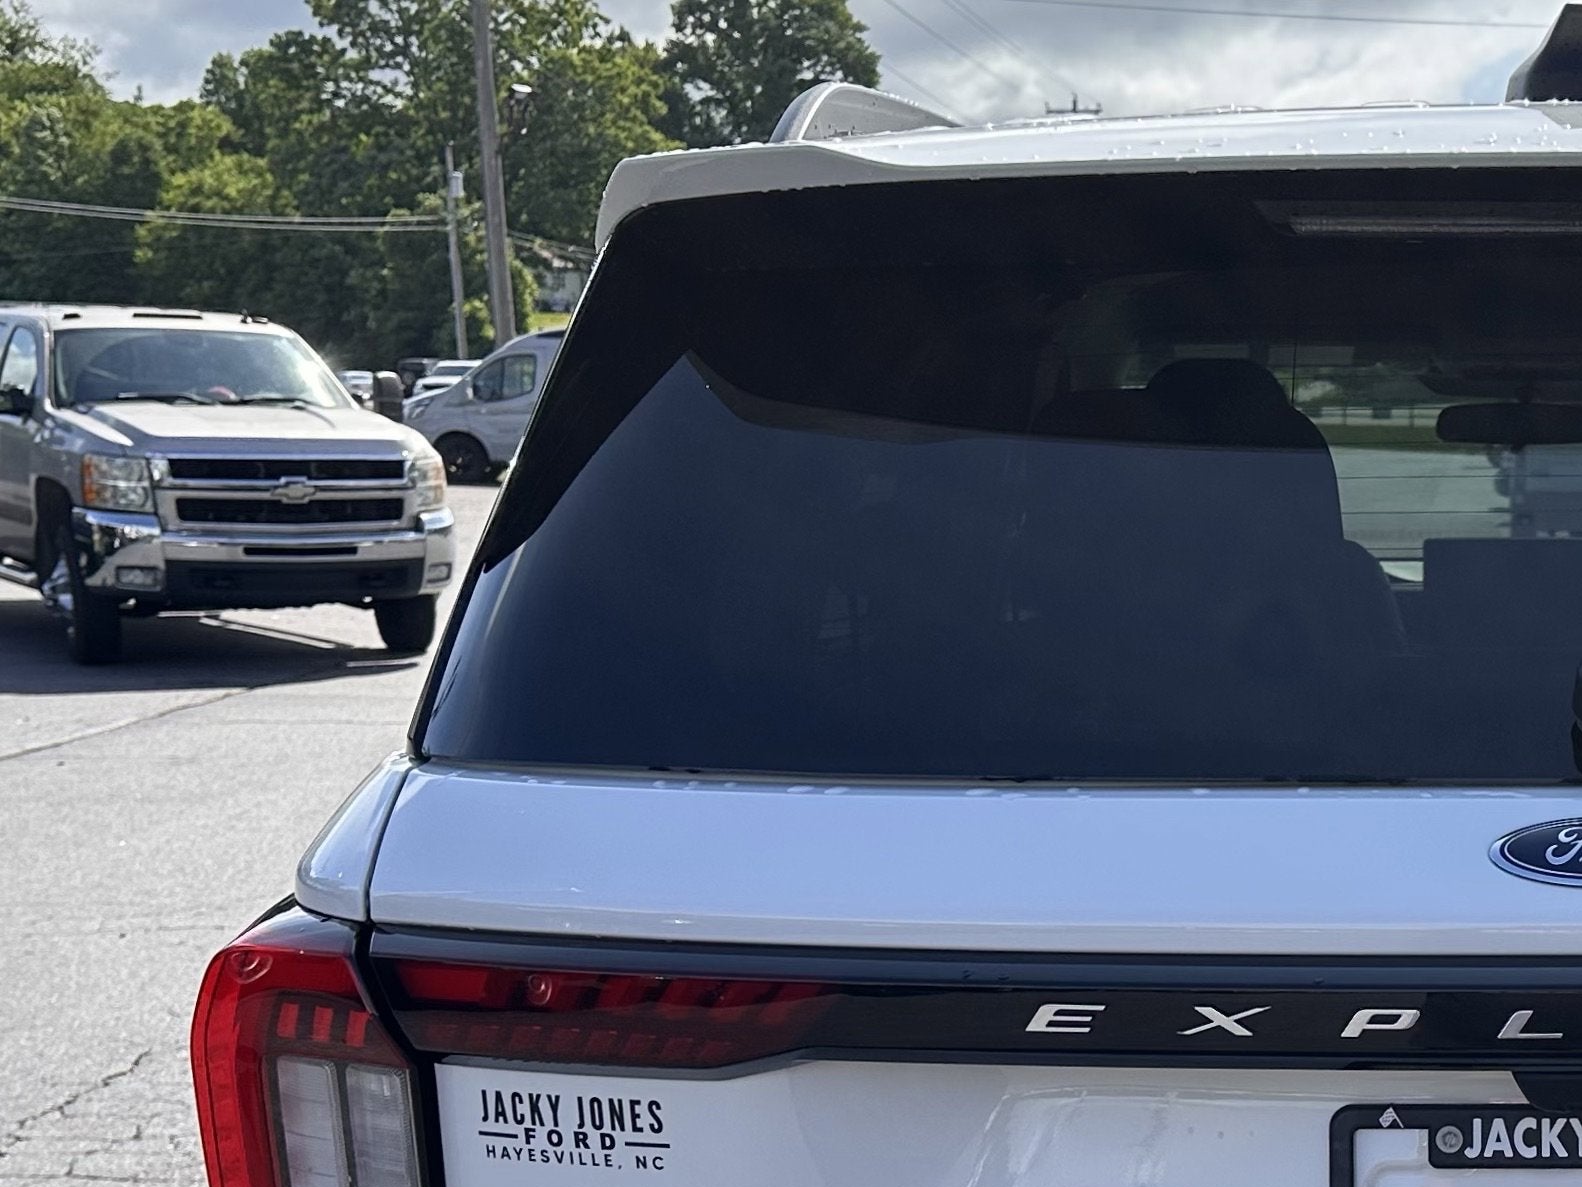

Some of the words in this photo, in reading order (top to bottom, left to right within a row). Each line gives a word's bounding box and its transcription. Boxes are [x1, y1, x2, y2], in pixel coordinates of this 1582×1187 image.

[481, 1089, 560, 1127] JACKY
[577, 1096, 664, 1134] JONES
[523, 1127, 616, 1150] FORD
[486, 1144, 622, 1169] HAYESVILLE,
[635, 1155, 665, 1170] NC
